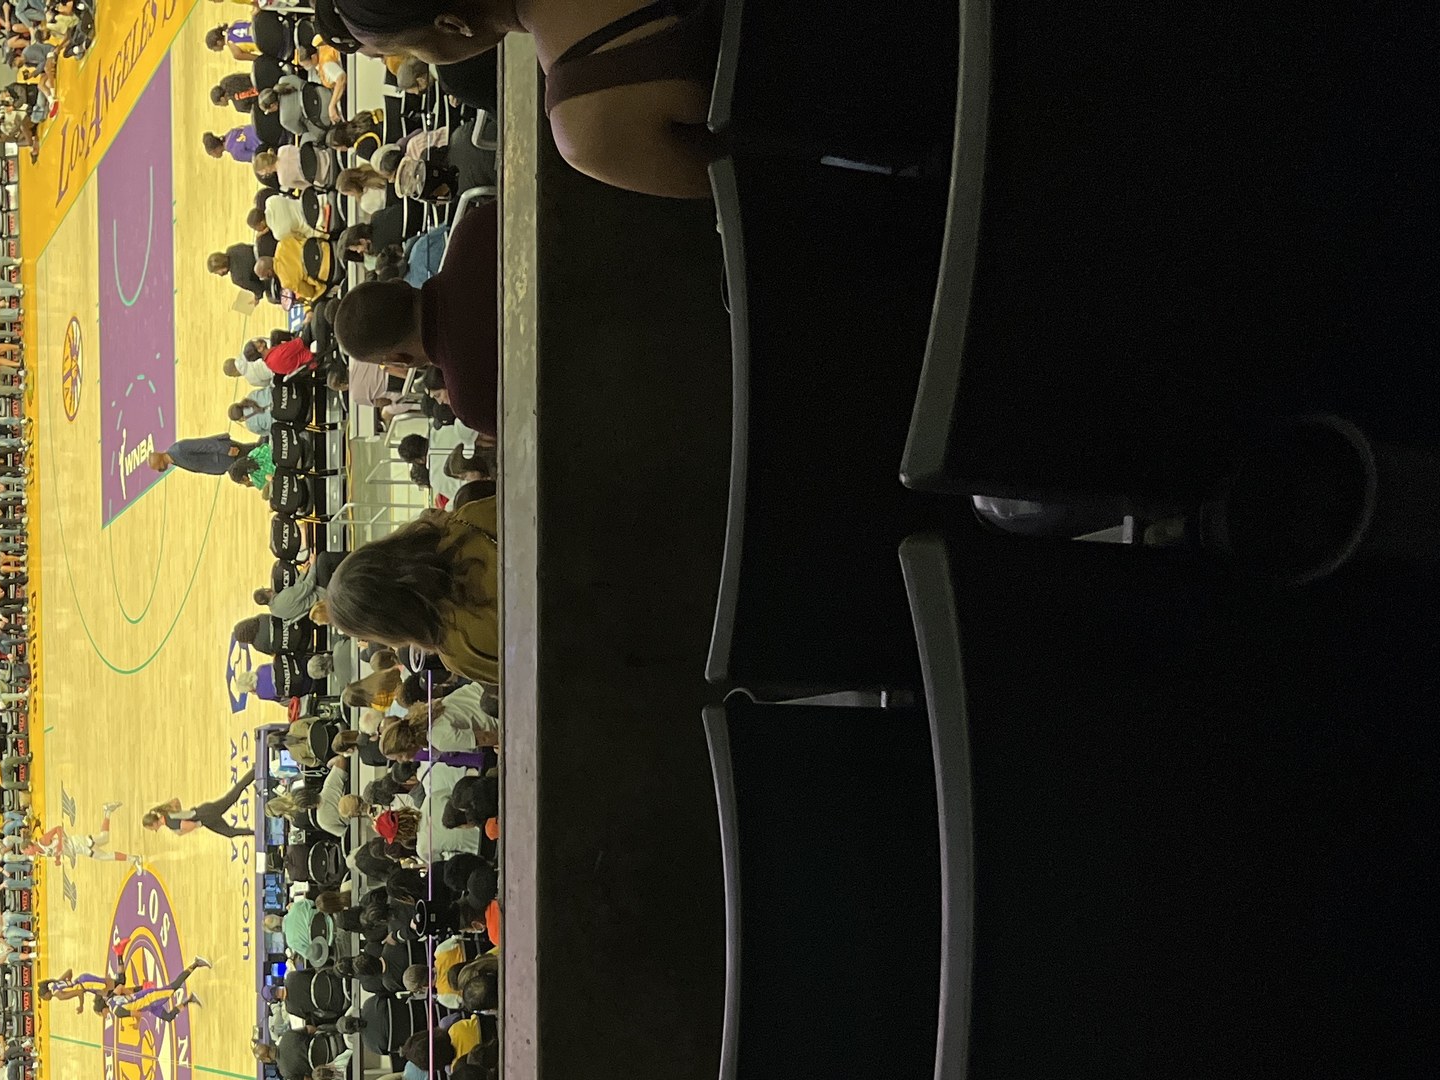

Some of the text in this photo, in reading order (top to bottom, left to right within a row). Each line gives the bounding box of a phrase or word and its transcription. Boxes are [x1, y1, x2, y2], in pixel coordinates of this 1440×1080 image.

[232, 28, 248, 38] 4
[280, 386, 288, 409] NASSI
[124, 433, 154, 476] WNBA
[280, 476, 288, 505] EHSANI
